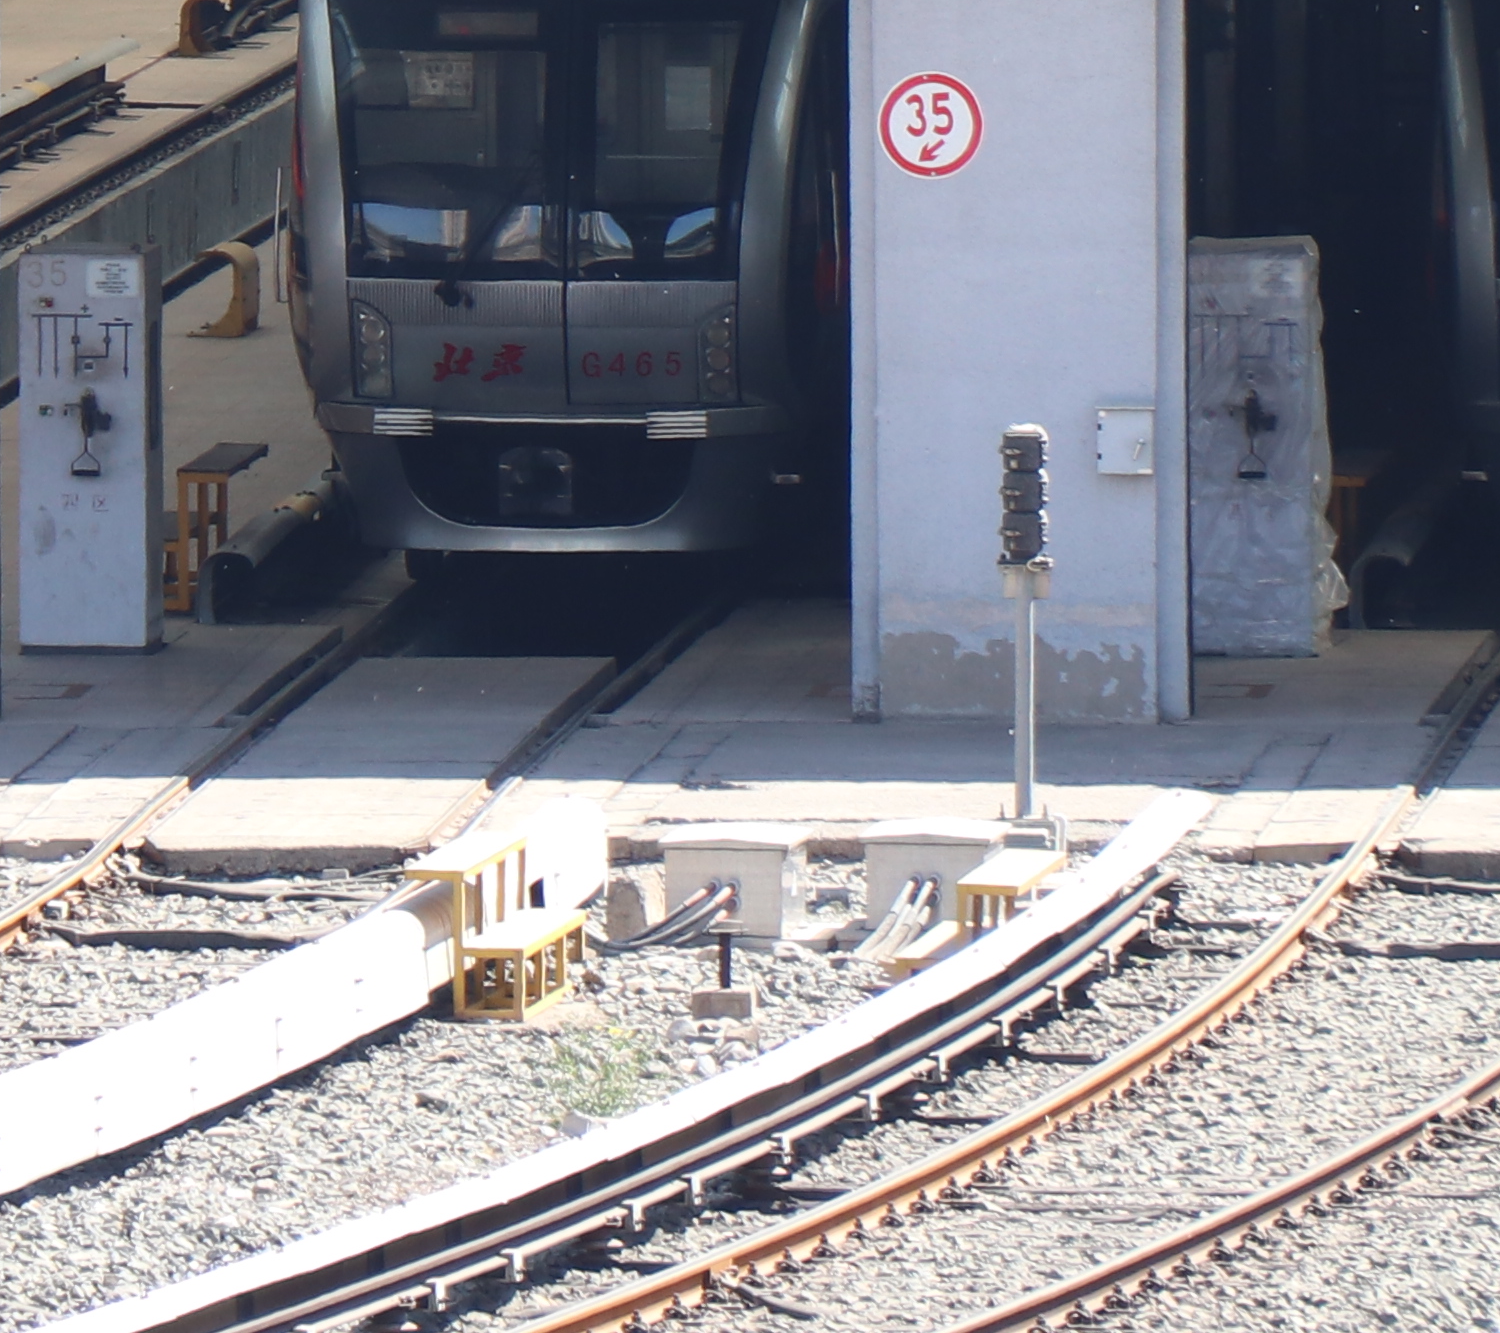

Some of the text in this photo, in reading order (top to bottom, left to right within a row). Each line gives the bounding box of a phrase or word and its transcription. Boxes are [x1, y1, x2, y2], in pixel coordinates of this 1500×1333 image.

[905, 92, 954, 137] 35
[26, 260, 67, 288] 35
[433, 343, 682, 382] 北京 G465
